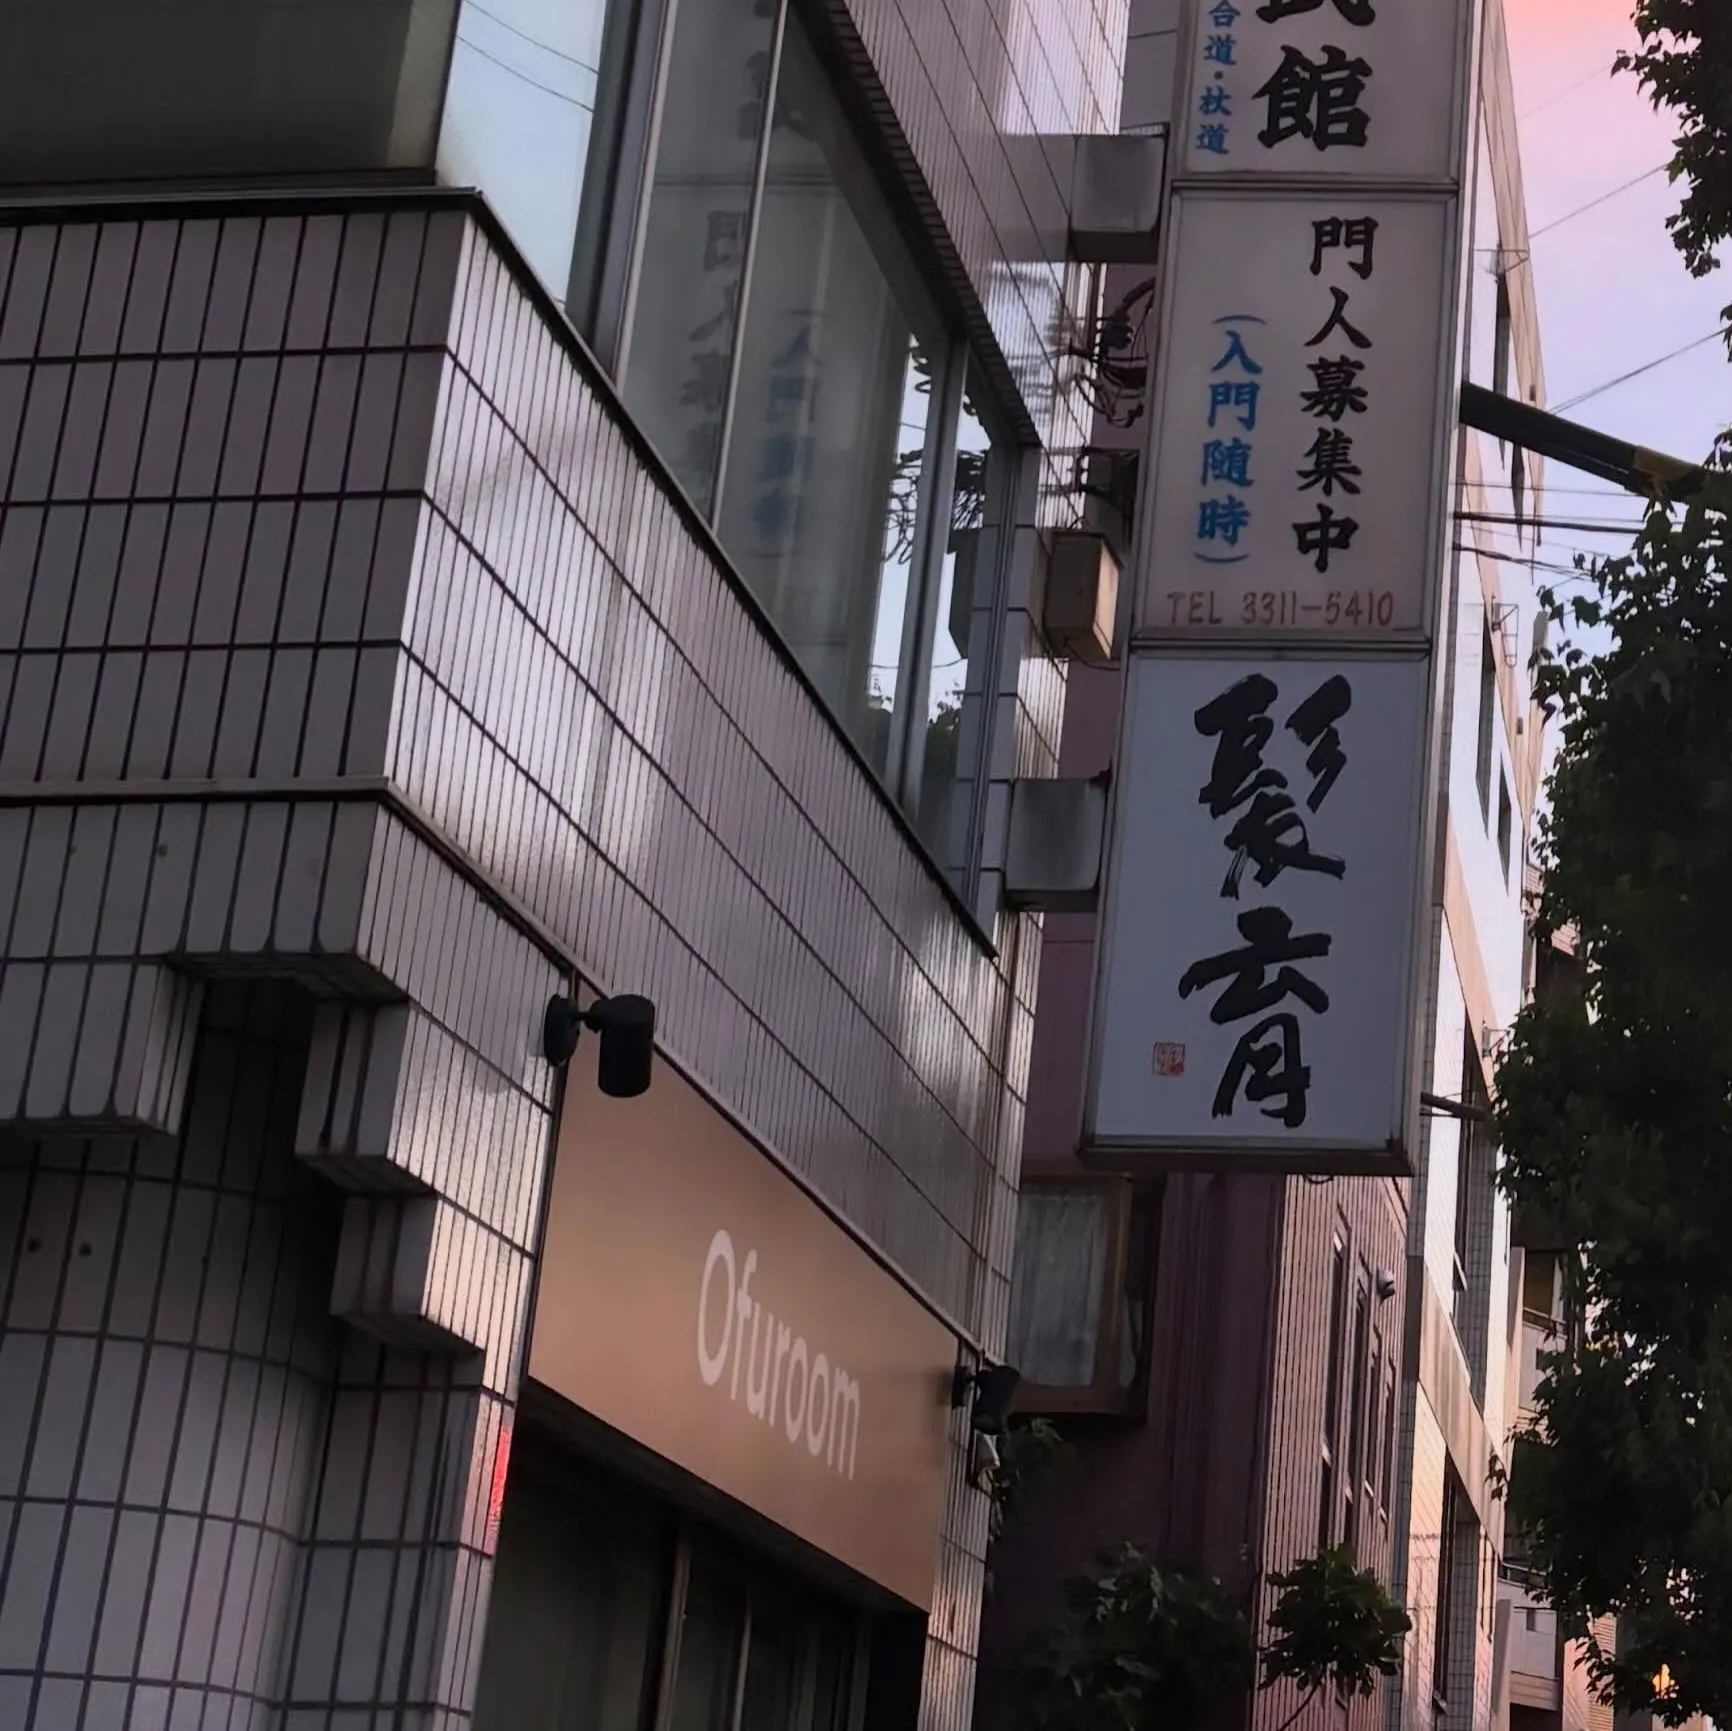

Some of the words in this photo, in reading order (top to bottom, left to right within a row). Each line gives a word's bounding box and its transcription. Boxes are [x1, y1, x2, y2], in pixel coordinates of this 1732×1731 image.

[1291, 216, 1379, 572] 門人募集中
[1166, 592, 1222, 626] TEL
[1241, 591, 1394, 627] 3311-5410
[698, 1229, 861, 1481] Ofuroom
